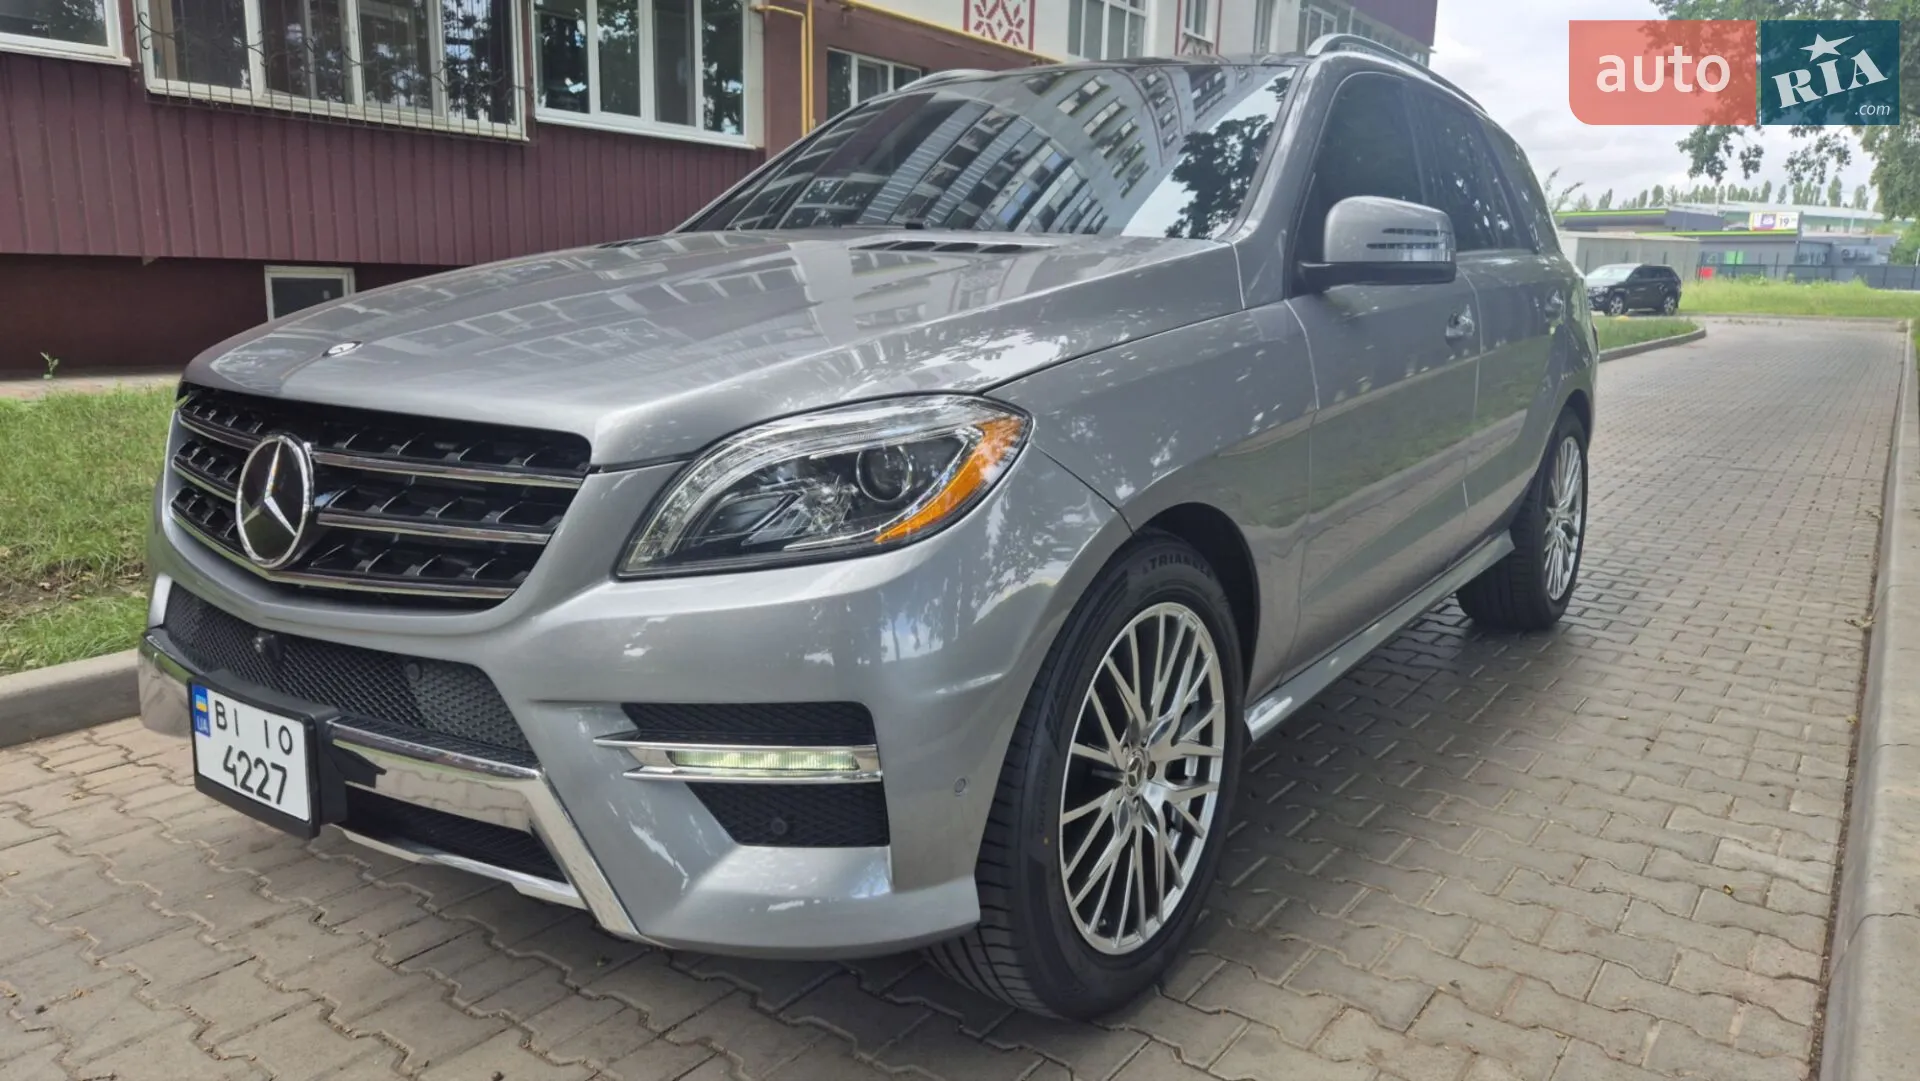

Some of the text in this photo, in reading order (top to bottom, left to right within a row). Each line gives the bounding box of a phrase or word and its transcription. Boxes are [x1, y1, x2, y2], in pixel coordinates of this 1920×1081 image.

[196, 717, 208, 732] UA
[215, 699, 293, 756] BI IO
[222, 745, 287, 805] 4227
